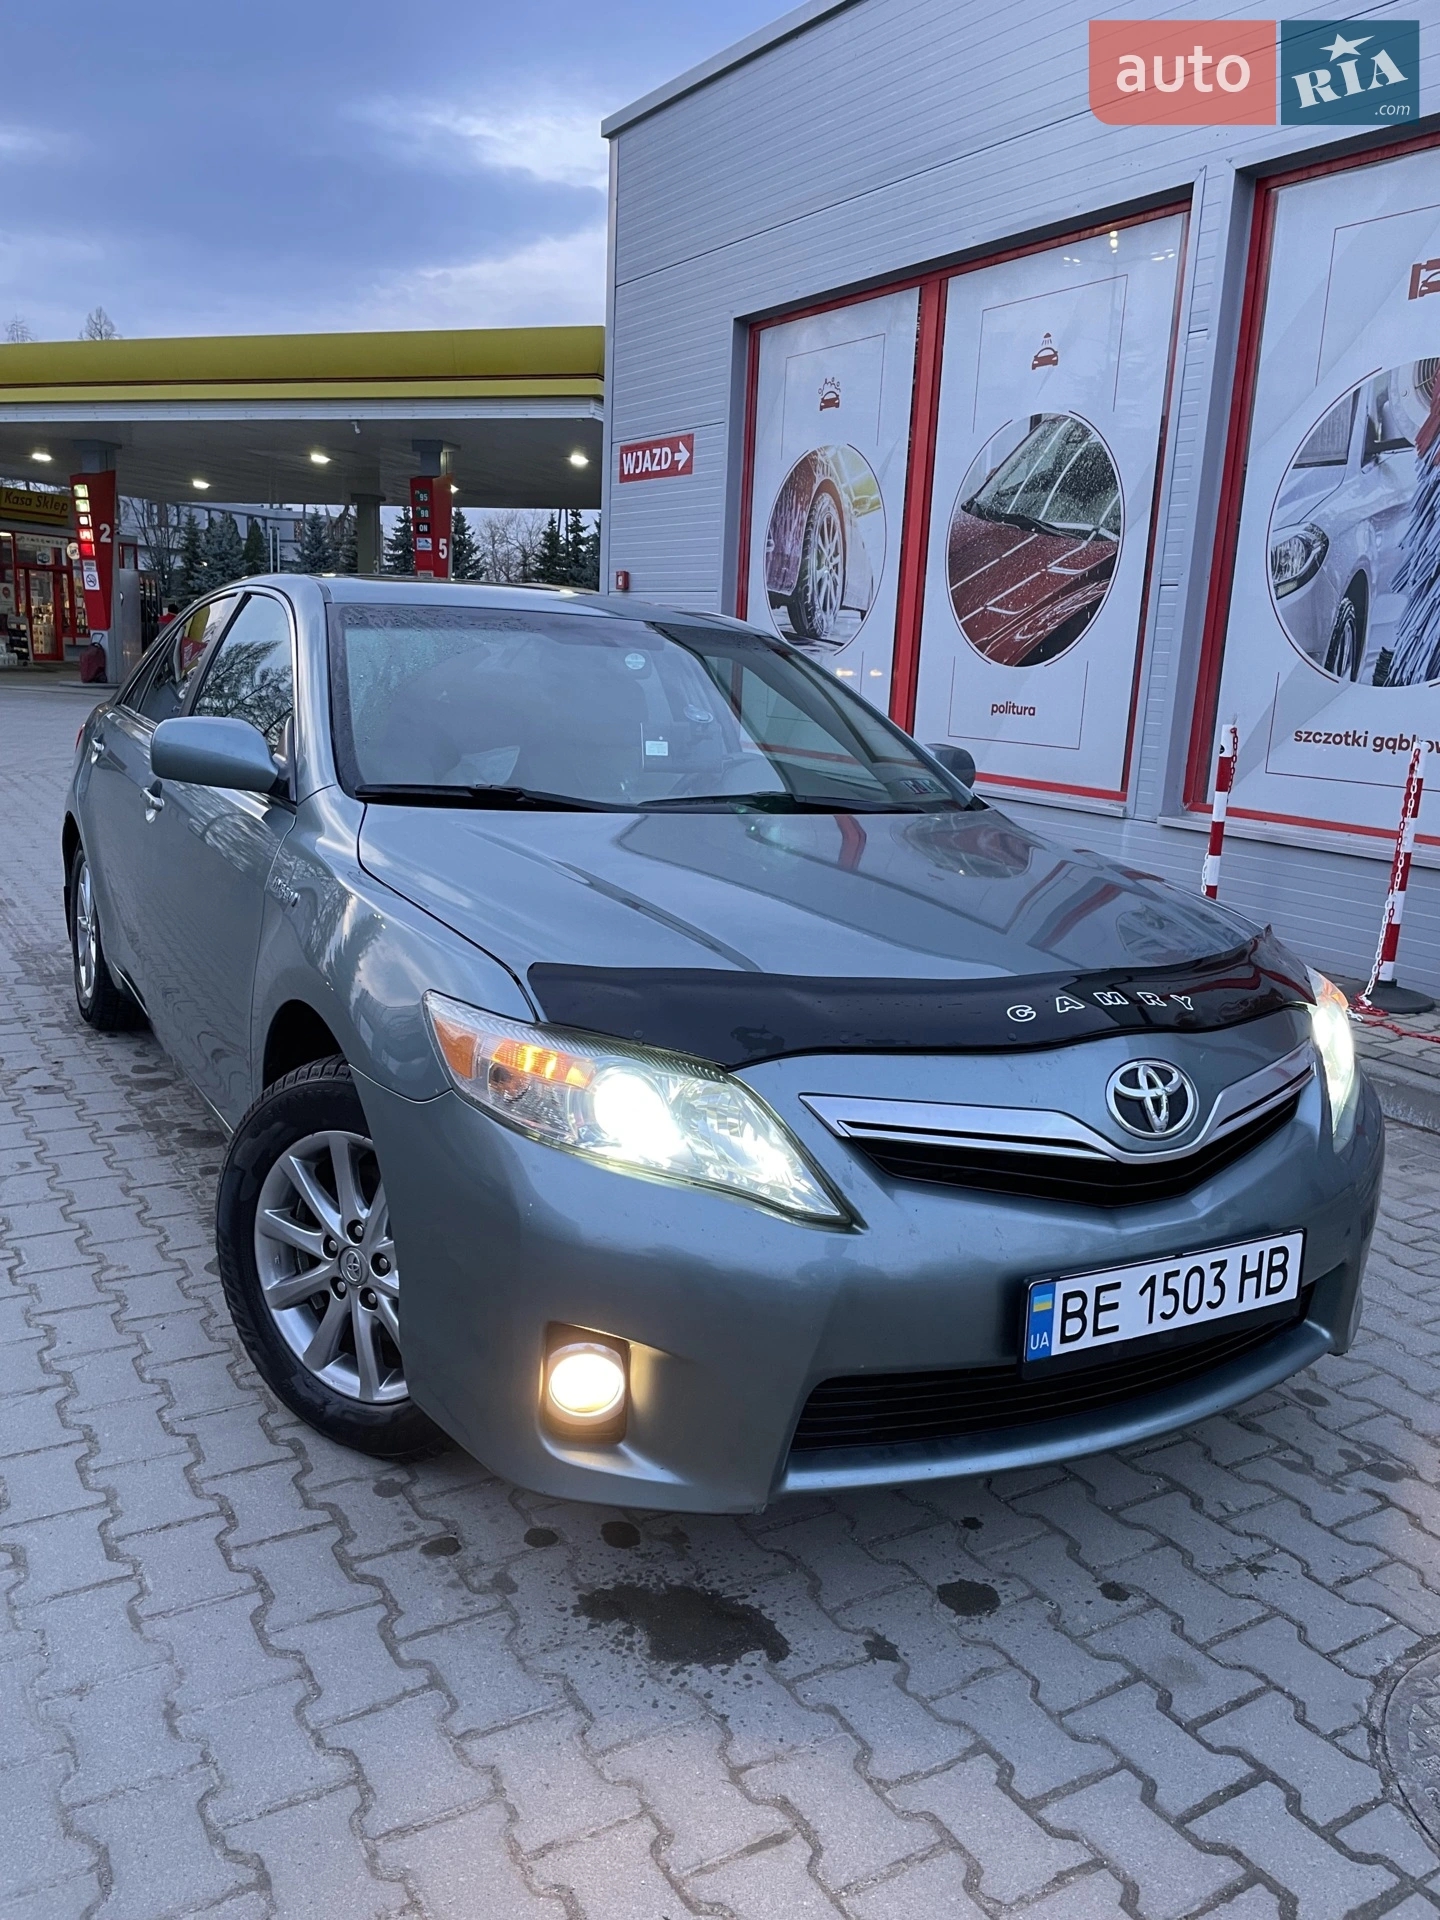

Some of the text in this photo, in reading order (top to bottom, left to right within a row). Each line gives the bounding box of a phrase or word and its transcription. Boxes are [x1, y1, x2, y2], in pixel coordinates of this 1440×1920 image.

[622, 446, 672, 475] WJAZD
[4, 491, 68, 514] Kasa Sklep
[419, 493, 428, 502] 95
[100, 523, 111, 543] 2
[419, 524, 428, 532] ON
[439, 538, 447, 559] 5
[990, 700, 1036, 717] politura
[1293, 729, 1369, 748] szczotki
[1006, 991, 1194, 1022] CAMRY
[1060, 1245, 1290, 1345] BE 1503 HB
[1030, 1331, 1050, 1351] UA
